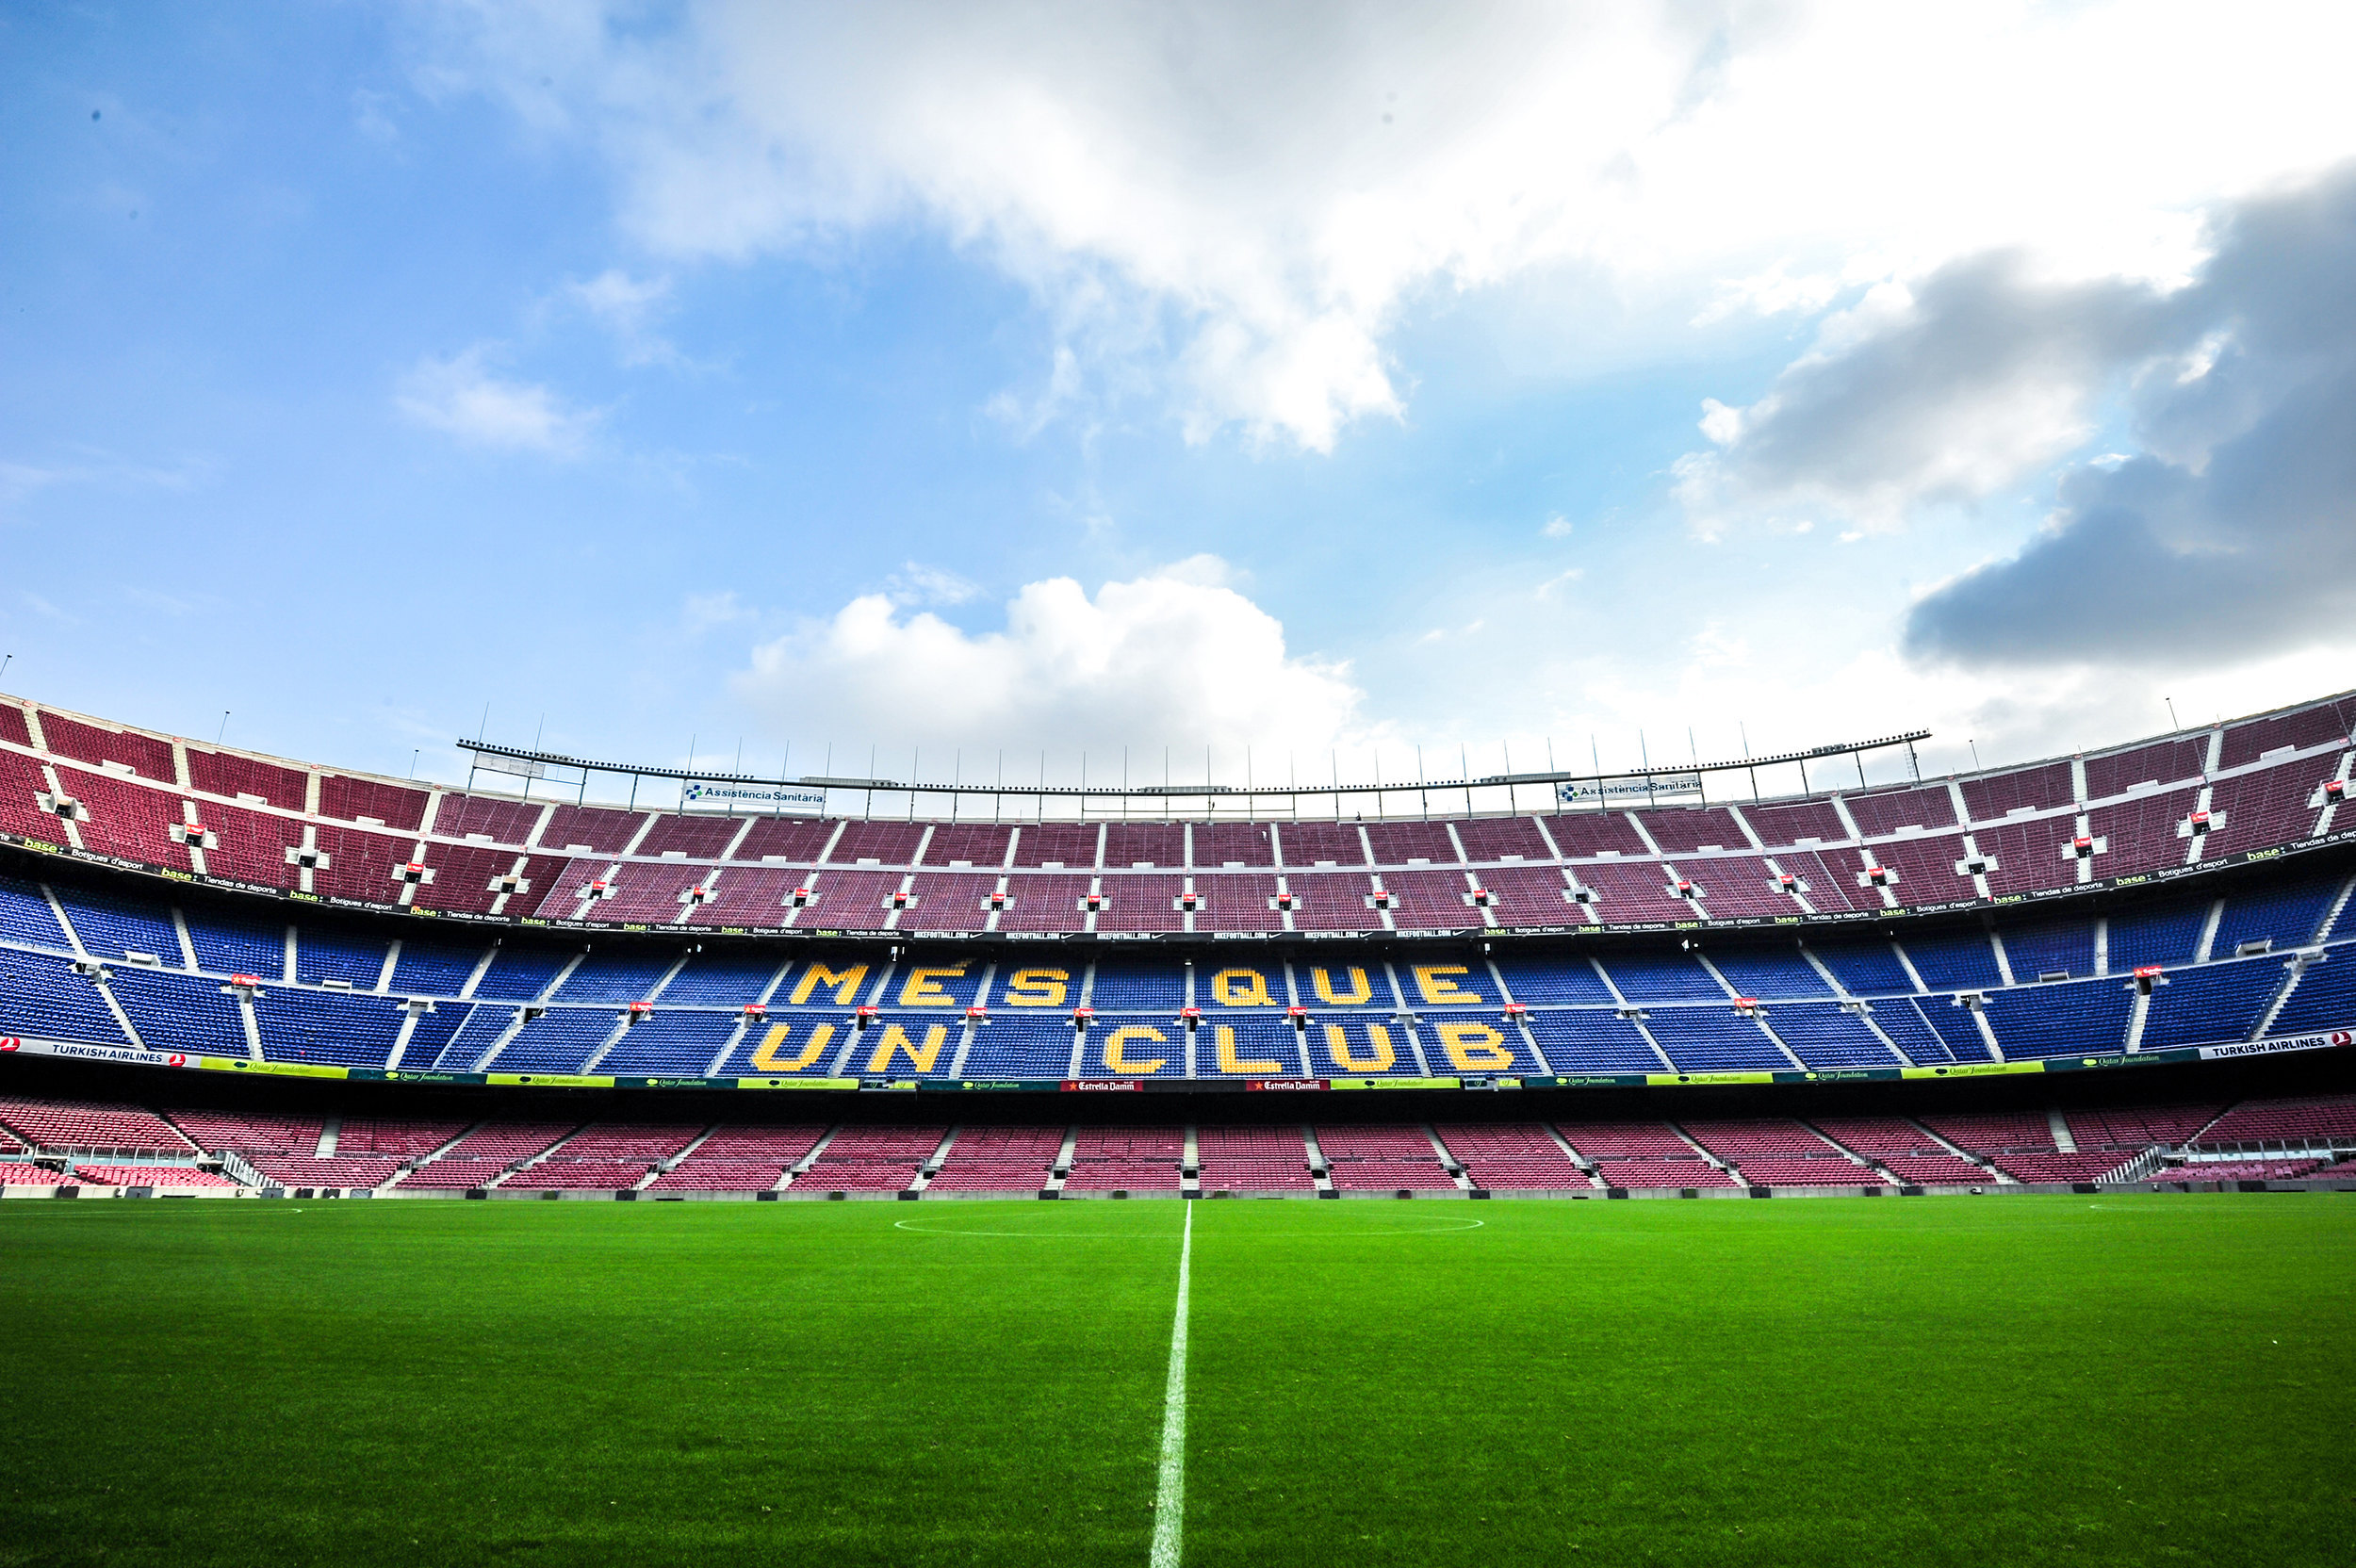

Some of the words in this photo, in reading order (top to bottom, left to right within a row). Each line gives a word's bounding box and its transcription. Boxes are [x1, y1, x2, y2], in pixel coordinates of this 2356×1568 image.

[705, 787, 771, 801] Assistència
[773, 791, 823, 803] Sanitària
[2290, 837, 2326, 850] Tiendas
[2327, 833, 2339, 842] de
[2158, 865, 2194, 878] Botigues
[204, 875, 235, 887] Tiendas
[247, 884, 277, 895] deporte
[2031, 888, 2061, 898] Tiendas
[2062, 886, 2072, 894] de
[2073, 882, 2103, 893] deporte
[447, 911, 472, 920] Tiendas
[484, 915, 510, 923] deporte
[789, 958, 1069, 1007] MÉS
[1212, 964, 1481, 1007] QUE
[53, 1044, 107, 1057] TURKISH
[108, 1050, 163, 1063] AIRLINES
[751, 1023, 946, 1073] UN
[1104, 1022, 1514, 1074] CLUB
[2213, 1043, 2266, 1057] TURKISH
[2268, 1037, 2325, 1052] AIRLINES
[2098, 1057, 2119, 1067] Qatar
[2119, 1054, 2159, 1066] Foundation
[1949, 1067, 1969, 1075] Qatar
[1971, 1066, 2006, 1074] Foundation
[1078, 1082, 1108, 1090] Estrella
[1109, 1082, 1135, 1091] Damm
[1264, 1081, 1295, 1090] Estrella
[1296, 1082, 1320, 1090] Damm
